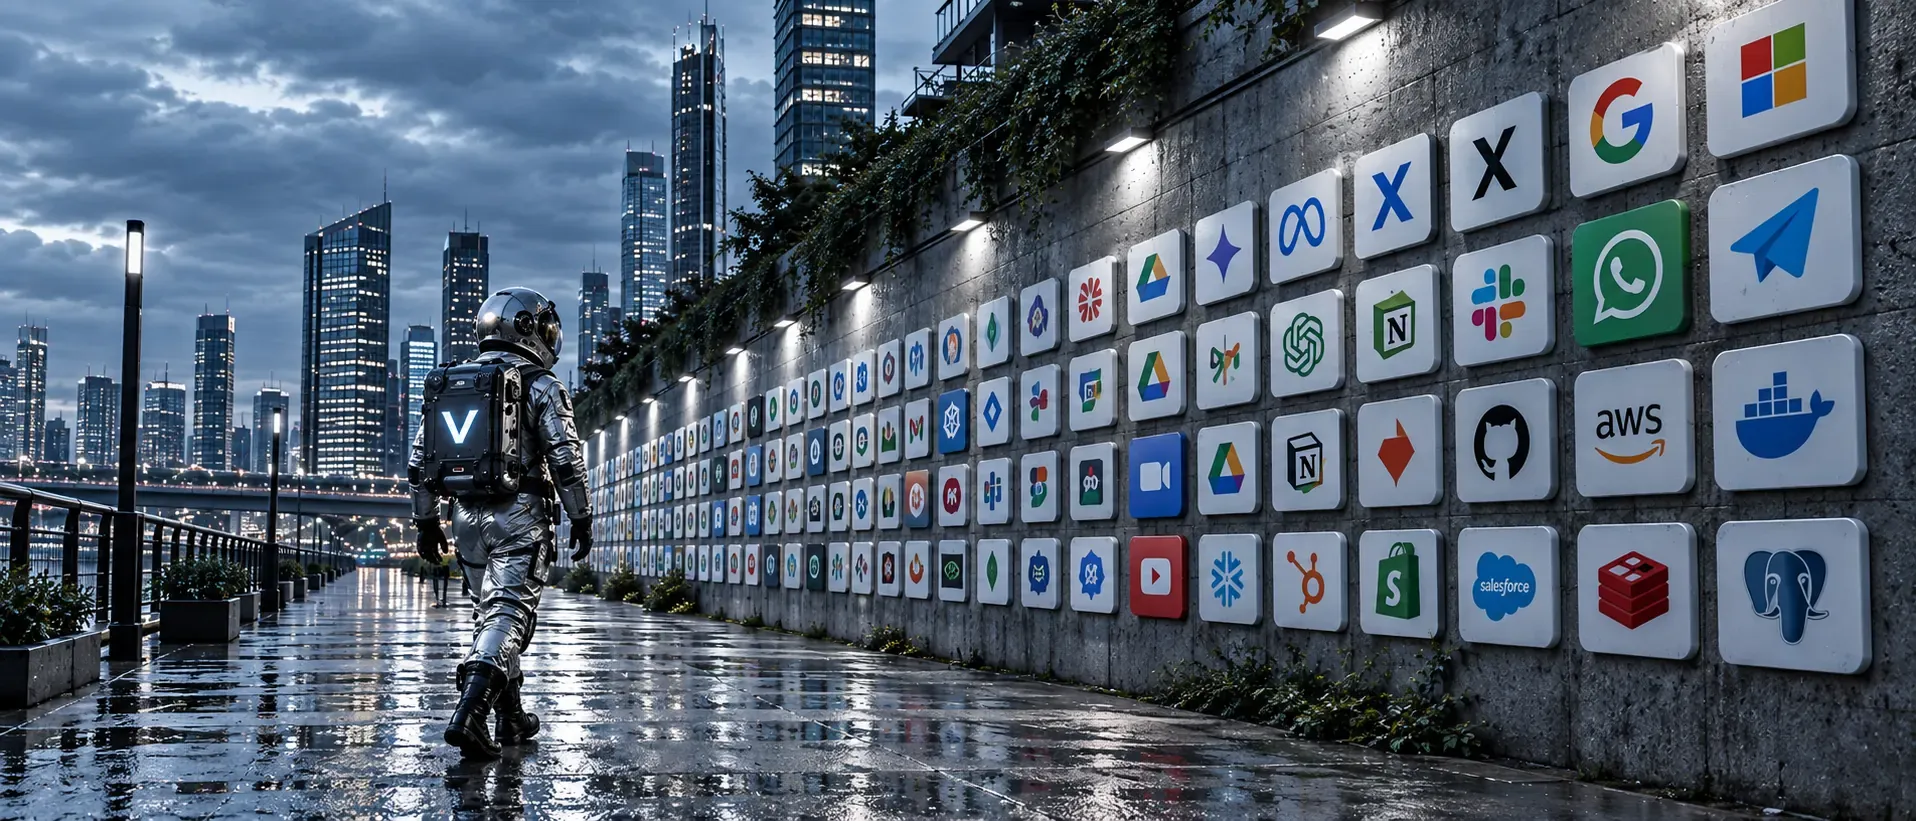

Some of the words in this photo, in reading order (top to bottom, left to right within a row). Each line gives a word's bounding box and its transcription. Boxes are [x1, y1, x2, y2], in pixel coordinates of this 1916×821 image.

[1590, 77, 1653, 164] G
[1472, 125, 1517, 201] X
[1372, 161, 1414, 231] X
[1387, 313, 1408, 345] N
[441, 409, 479, 444] V
[1596, 404, 1662, 439] aws
[1299, 454, 1316, 479] N
[1385, 570, 1401, 607] S
[1480, 578, 1530, 597] salesforce
